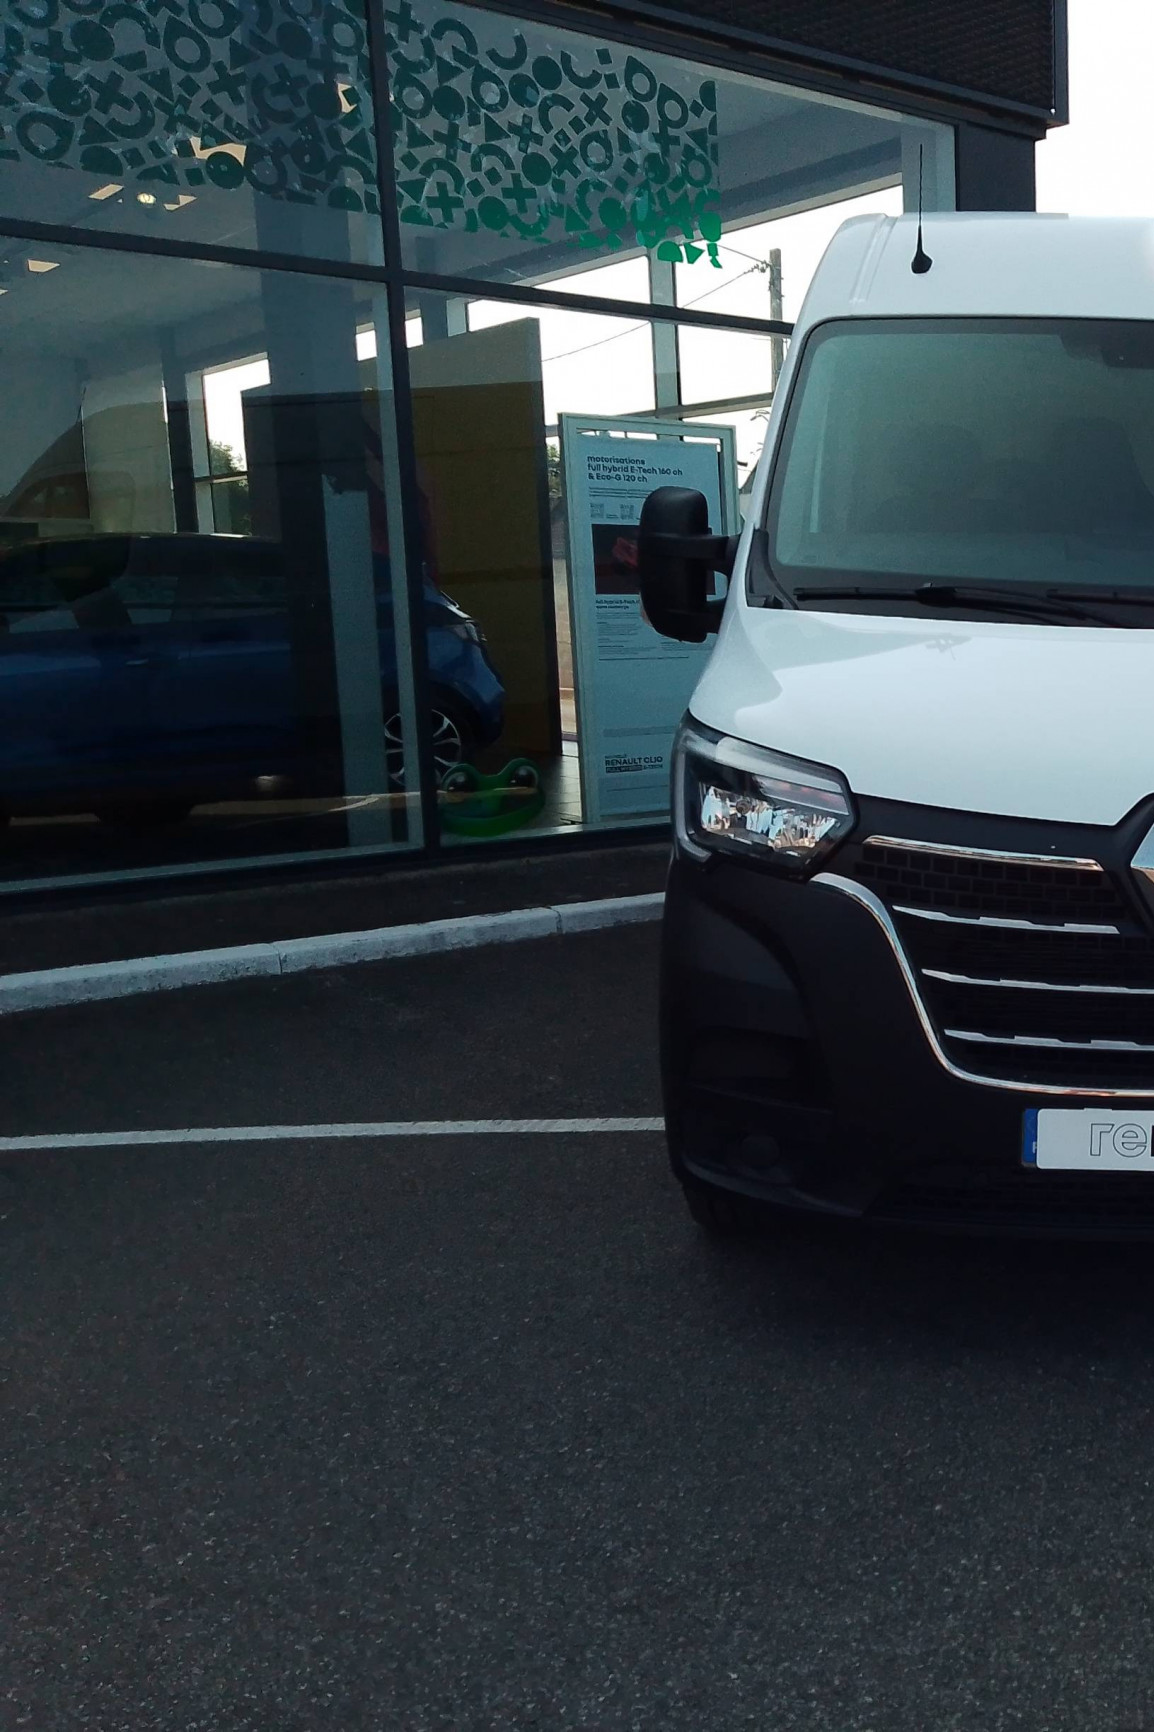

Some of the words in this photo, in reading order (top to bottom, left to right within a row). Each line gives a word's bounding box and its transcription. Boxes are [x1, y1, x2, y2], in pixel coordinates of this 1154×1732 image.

[587, 456, 645, 465] motorisations
[588, 463, 601, 471] full
[602, 464, 629, 473] hybrid
[631, 466, 657, 475] E-Tech
[596, 473, 621, 481] Eco-G
[623, 474, 636, 482] 120
[637, 475, 648, 483] ch
[605, 757, 642, 767] RENAULT
[643, 756, 663, 764] CLIO
